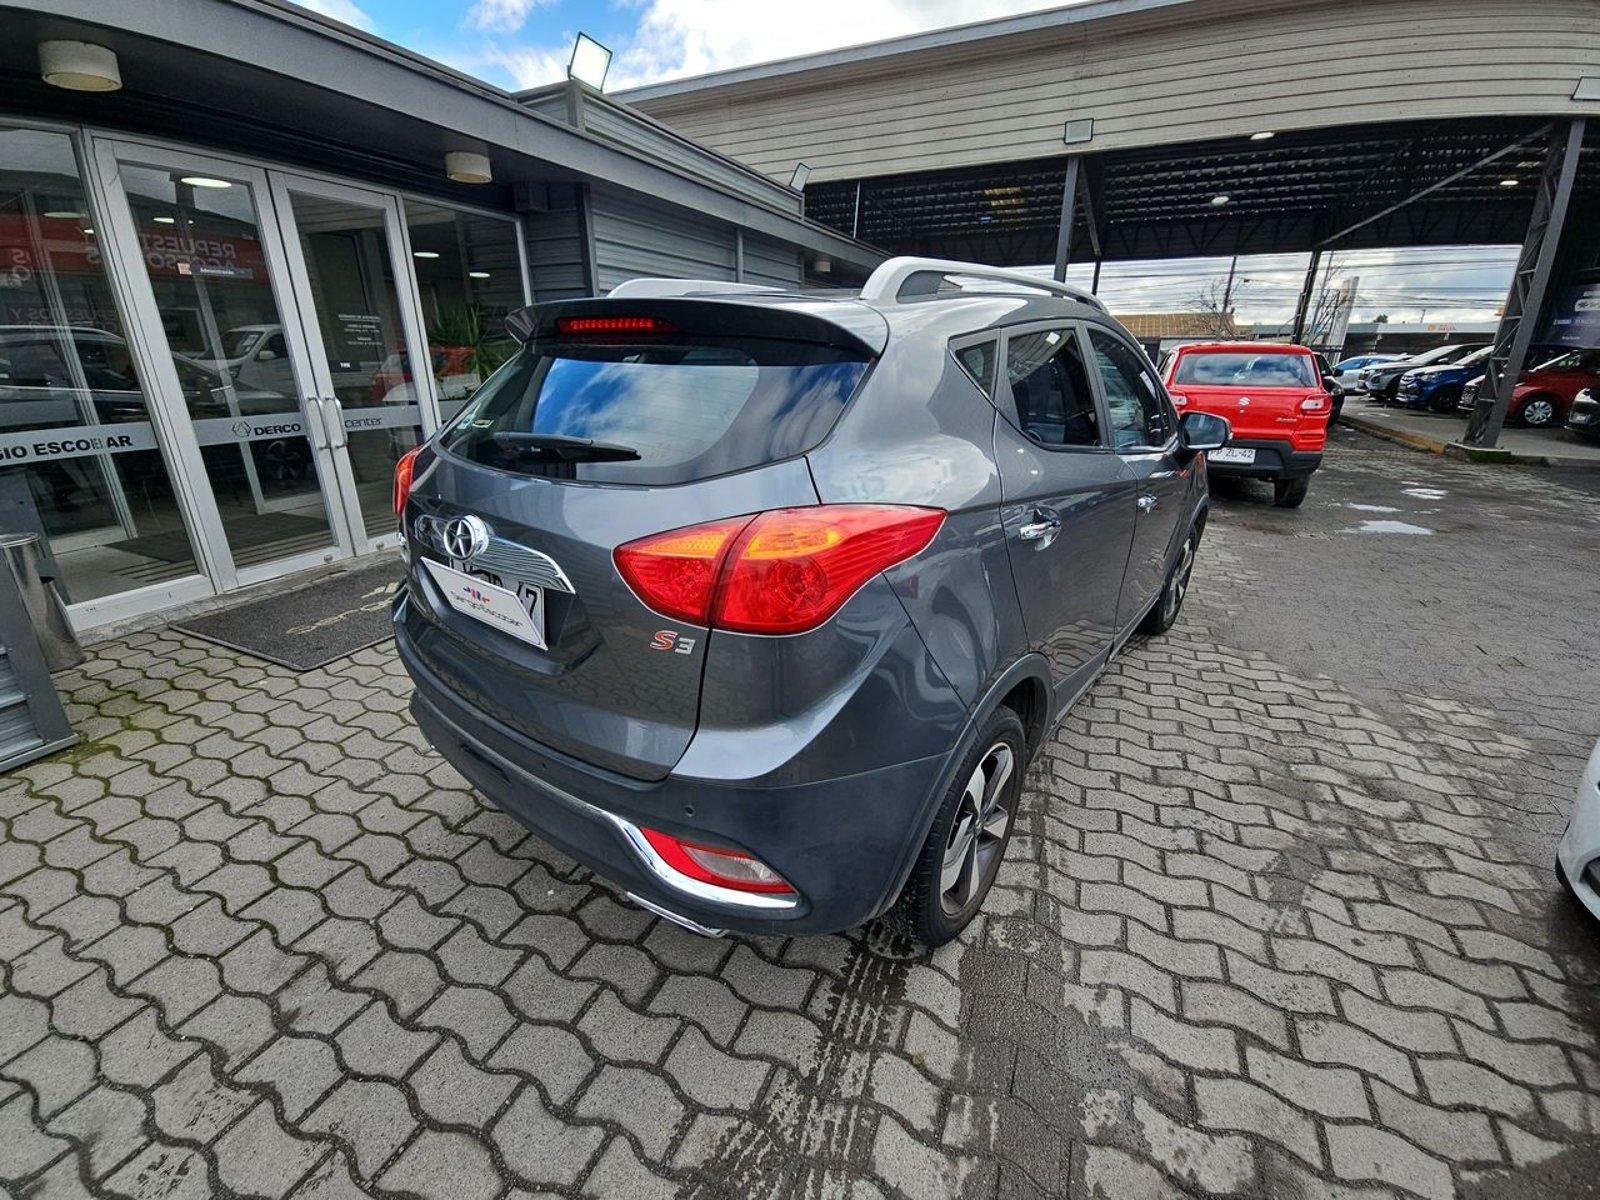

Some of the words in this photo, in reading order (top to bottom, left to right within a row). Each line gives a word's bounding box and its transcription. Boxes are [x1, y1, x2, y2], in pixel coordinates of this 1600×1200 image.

[254, 423, 301, 436] DERCO
[345, 417, 383, 429] center
[0, 445, 27, 461] IO
[650, 630, 696, 654] S3
